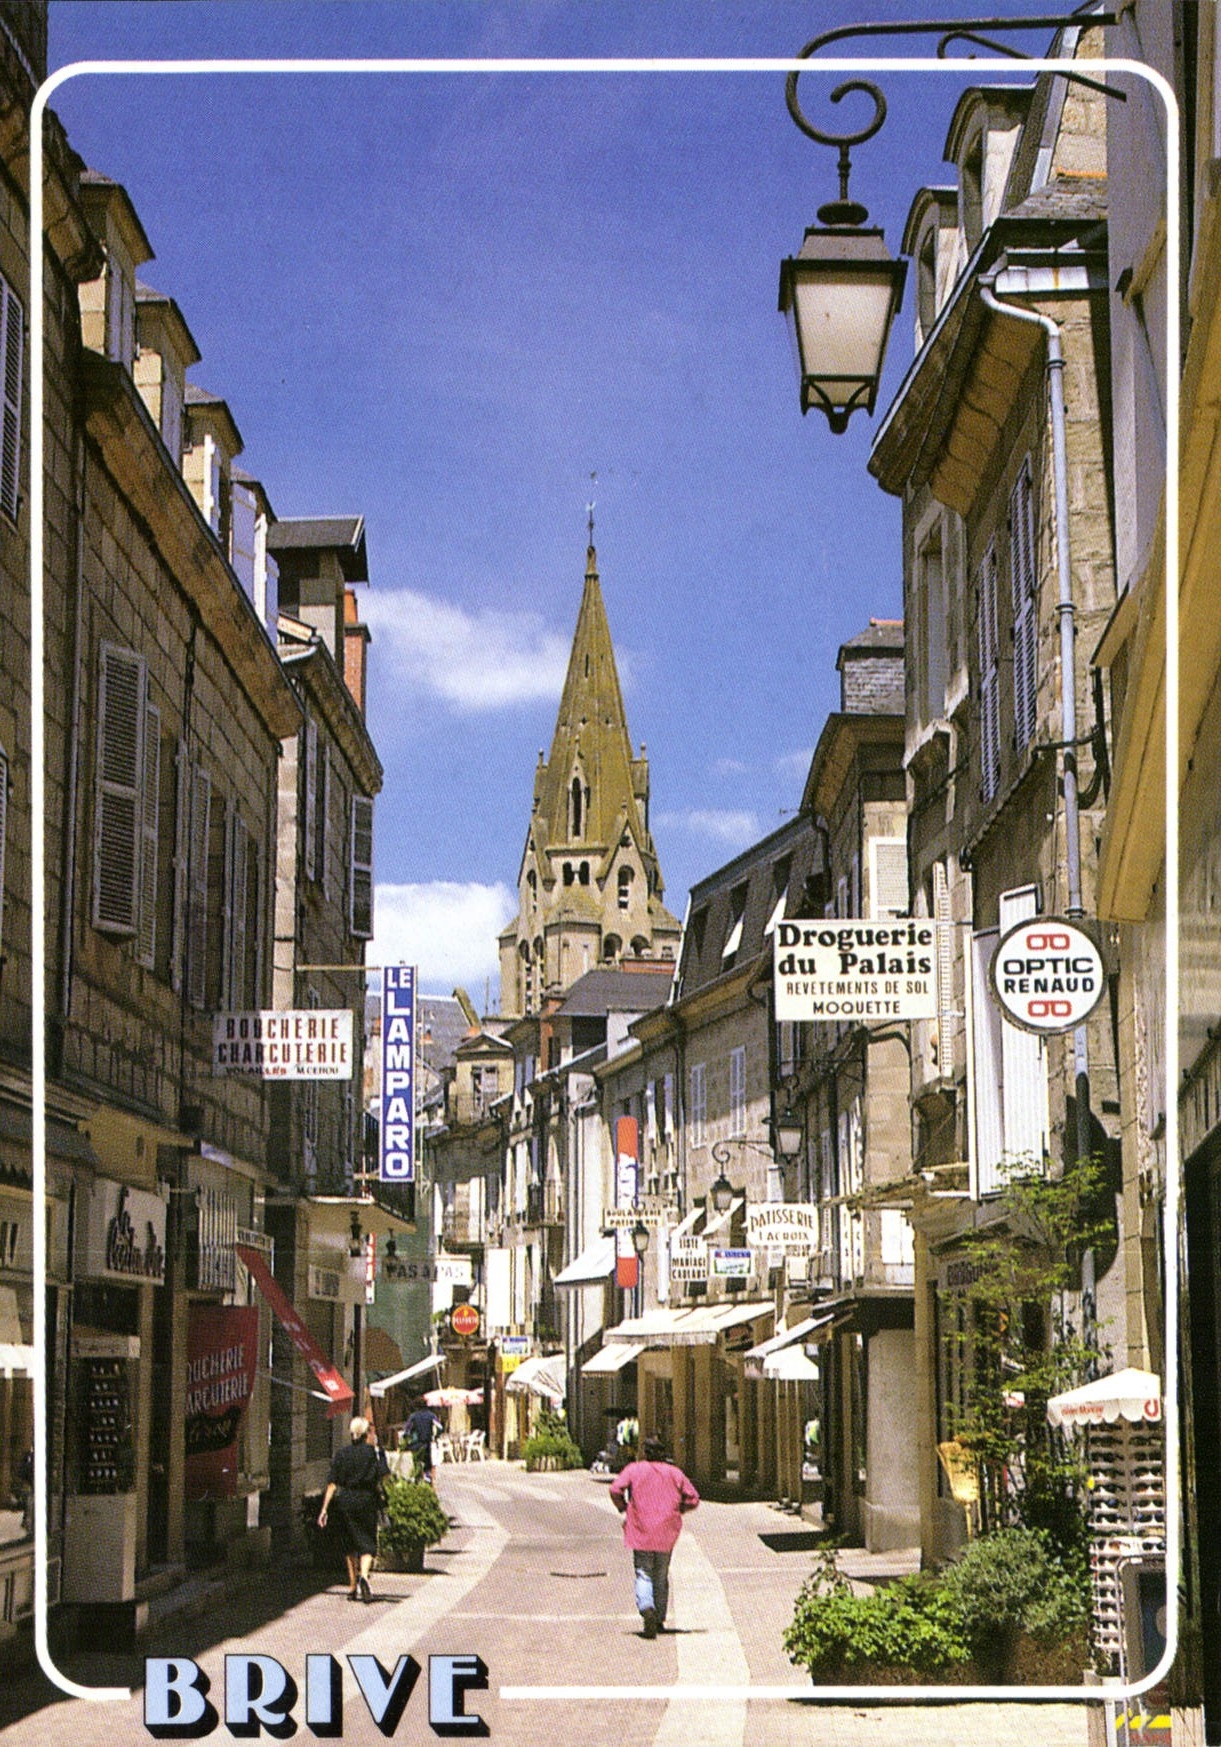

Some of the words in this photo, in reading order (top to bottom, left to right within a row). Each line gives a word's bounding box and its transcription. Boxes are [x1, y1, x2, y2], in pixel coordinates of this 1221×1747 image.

[778, 923, 933, 951] Droguerie
[778, 953, 817, 975] du
[839, 951, 931, 975] Palais
[1003, 957, 1094, 975] OPTIC
[387, 968, 411, 988] LE
[786, 981, 878, 995] REVETEMENTS
[885, 980, 900, 994] DE
[906, 980, 929, 994] SOL
[1004, 977, 1094, 993] RENAUD
[813, 1001, 901, 1015] MOQUETTE
[226, 1018, 339, 1040] BOUCHERIE
[218, 1042, 347, 1064] CHARCUTERIE
[385, 991, 411, 1177] LAMPARO
[750, 1208, 814, 1233] PATISSERIE
[759, 1231, 809, 1241] LACROIX
